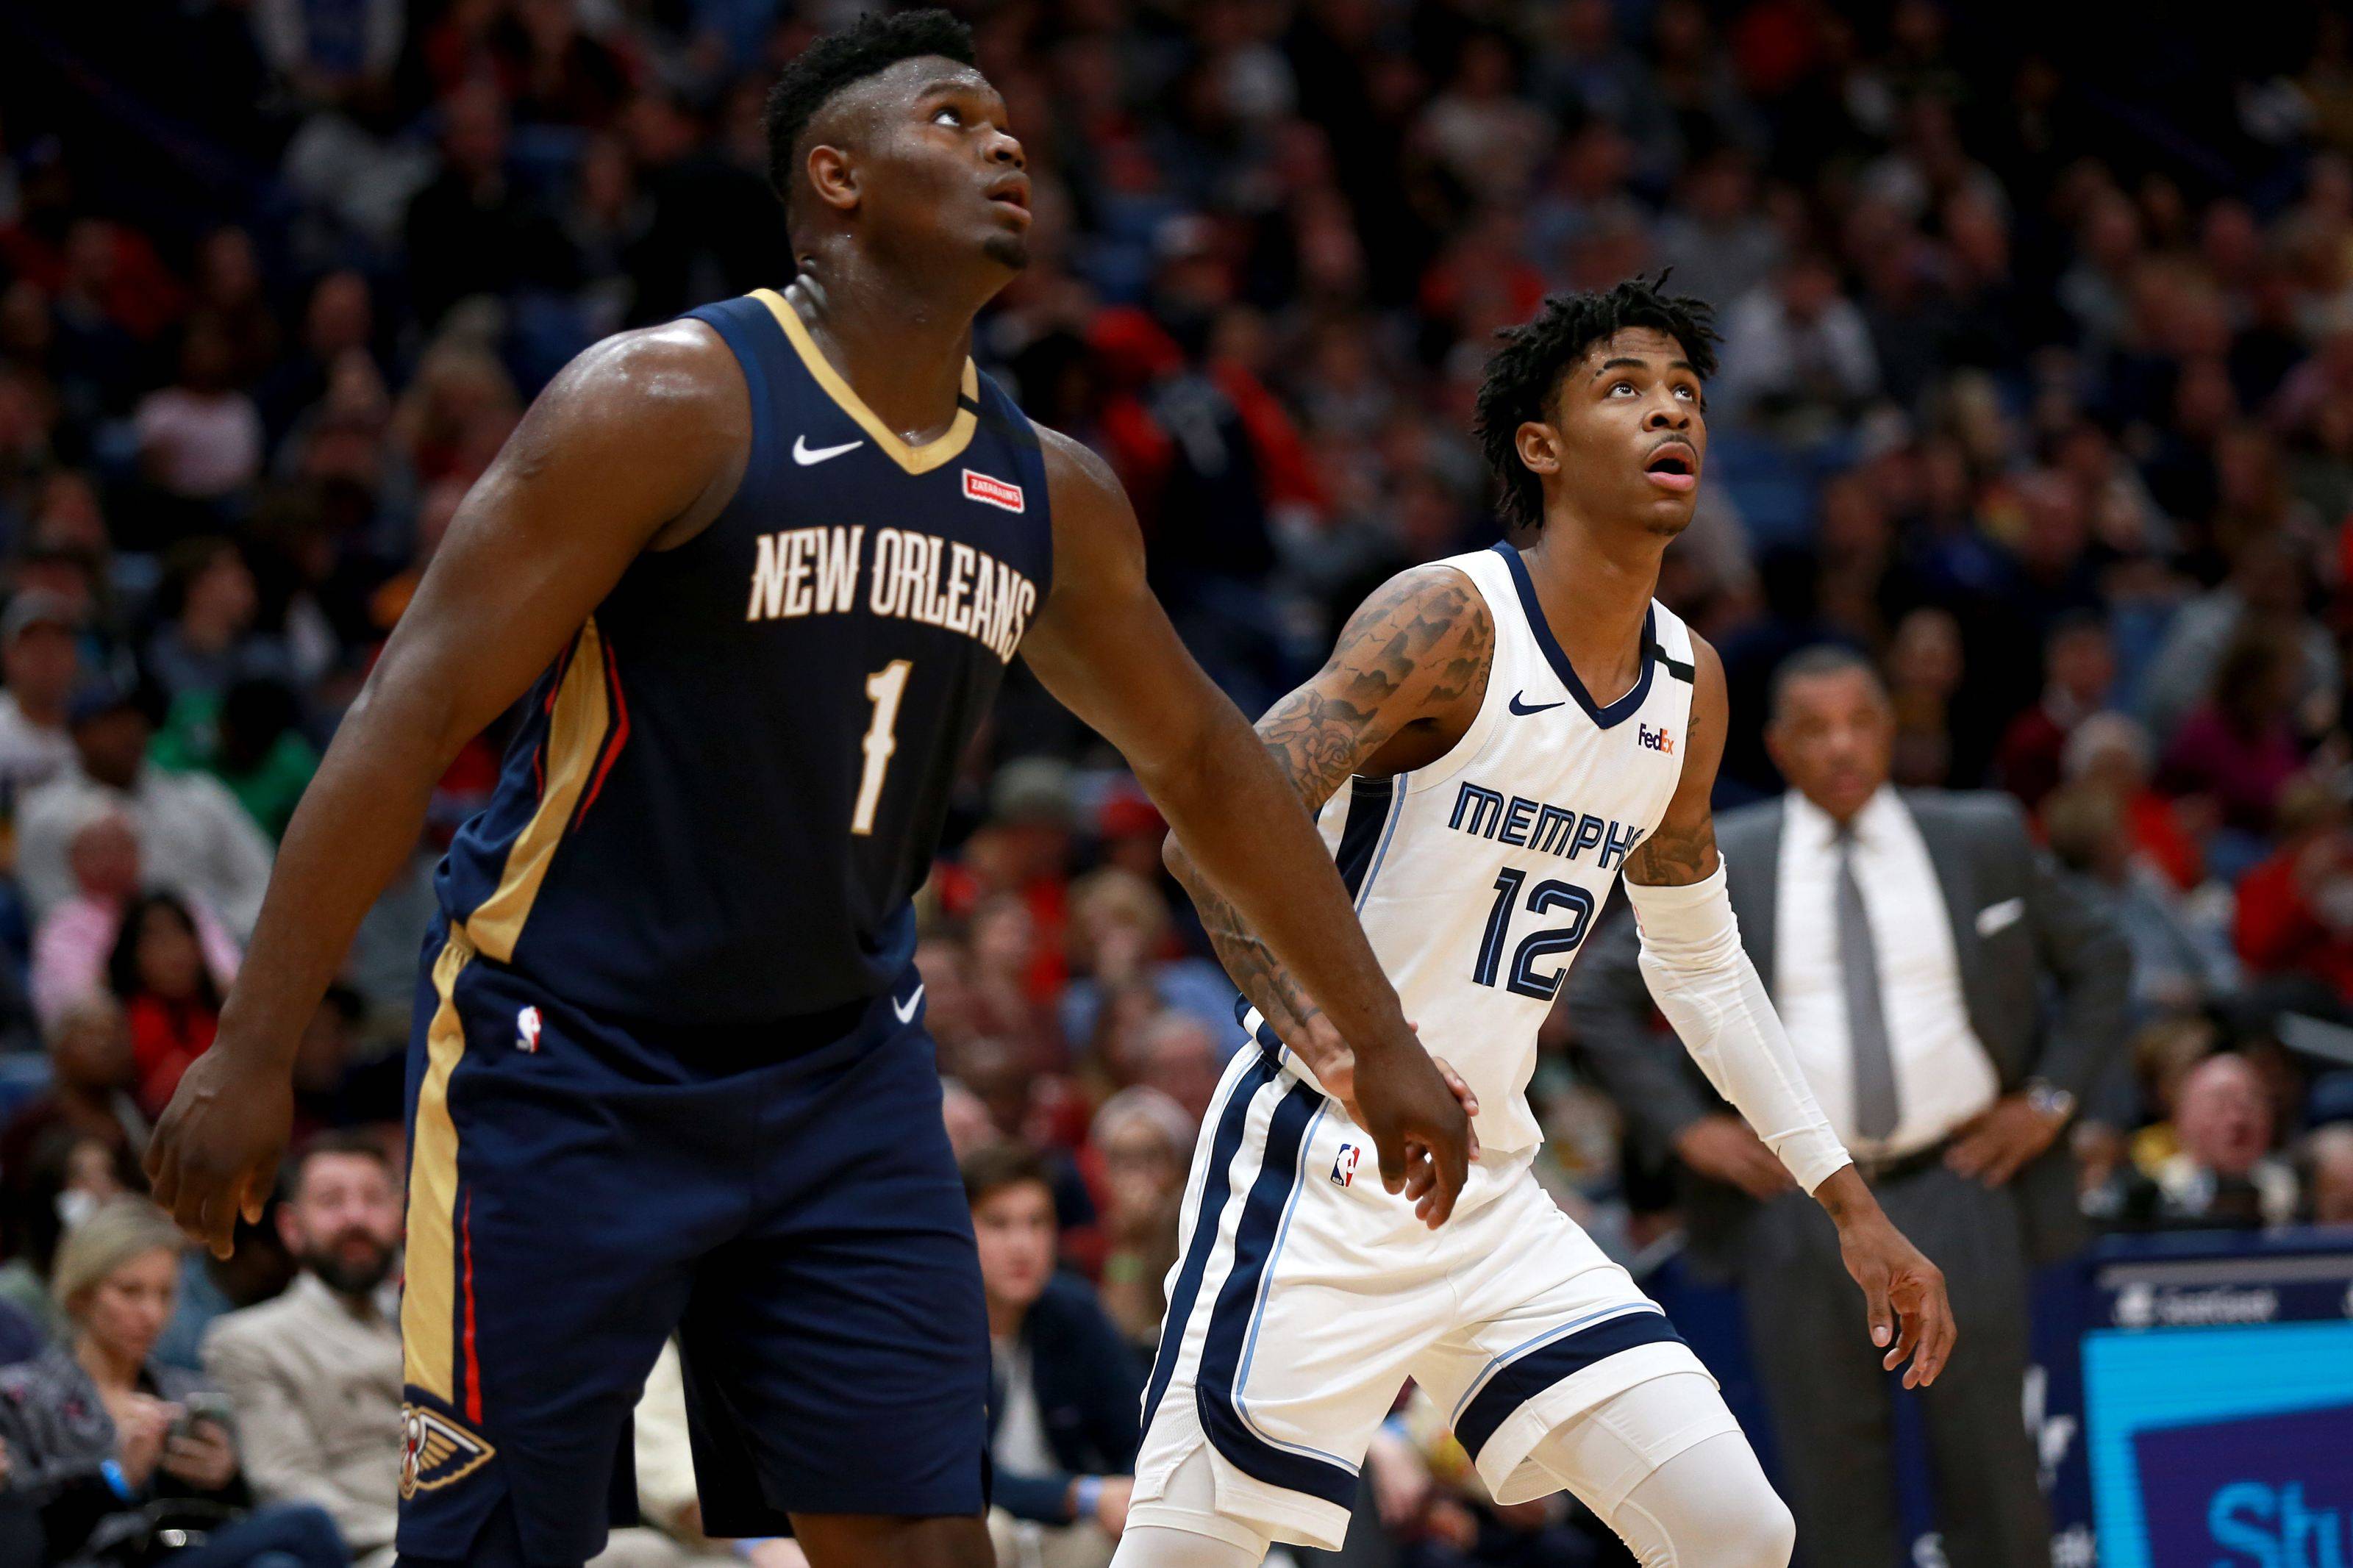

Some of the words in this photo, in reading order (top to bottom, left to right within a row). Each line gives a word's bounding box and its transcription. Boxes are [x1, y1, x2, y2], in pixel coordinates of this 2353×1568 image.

[746, 525, 865, 622] NEW
[869, 527, 1036, 663] ORLEANS
[851, 659, 913, 835] 1
[1638, 723, 1674, 755] FedEx
[1447, 781, 1645, 871] MEMPH
[1472, 867, 1595, 1001] 12
[1332, 1176, 1342, 1185] NBA
